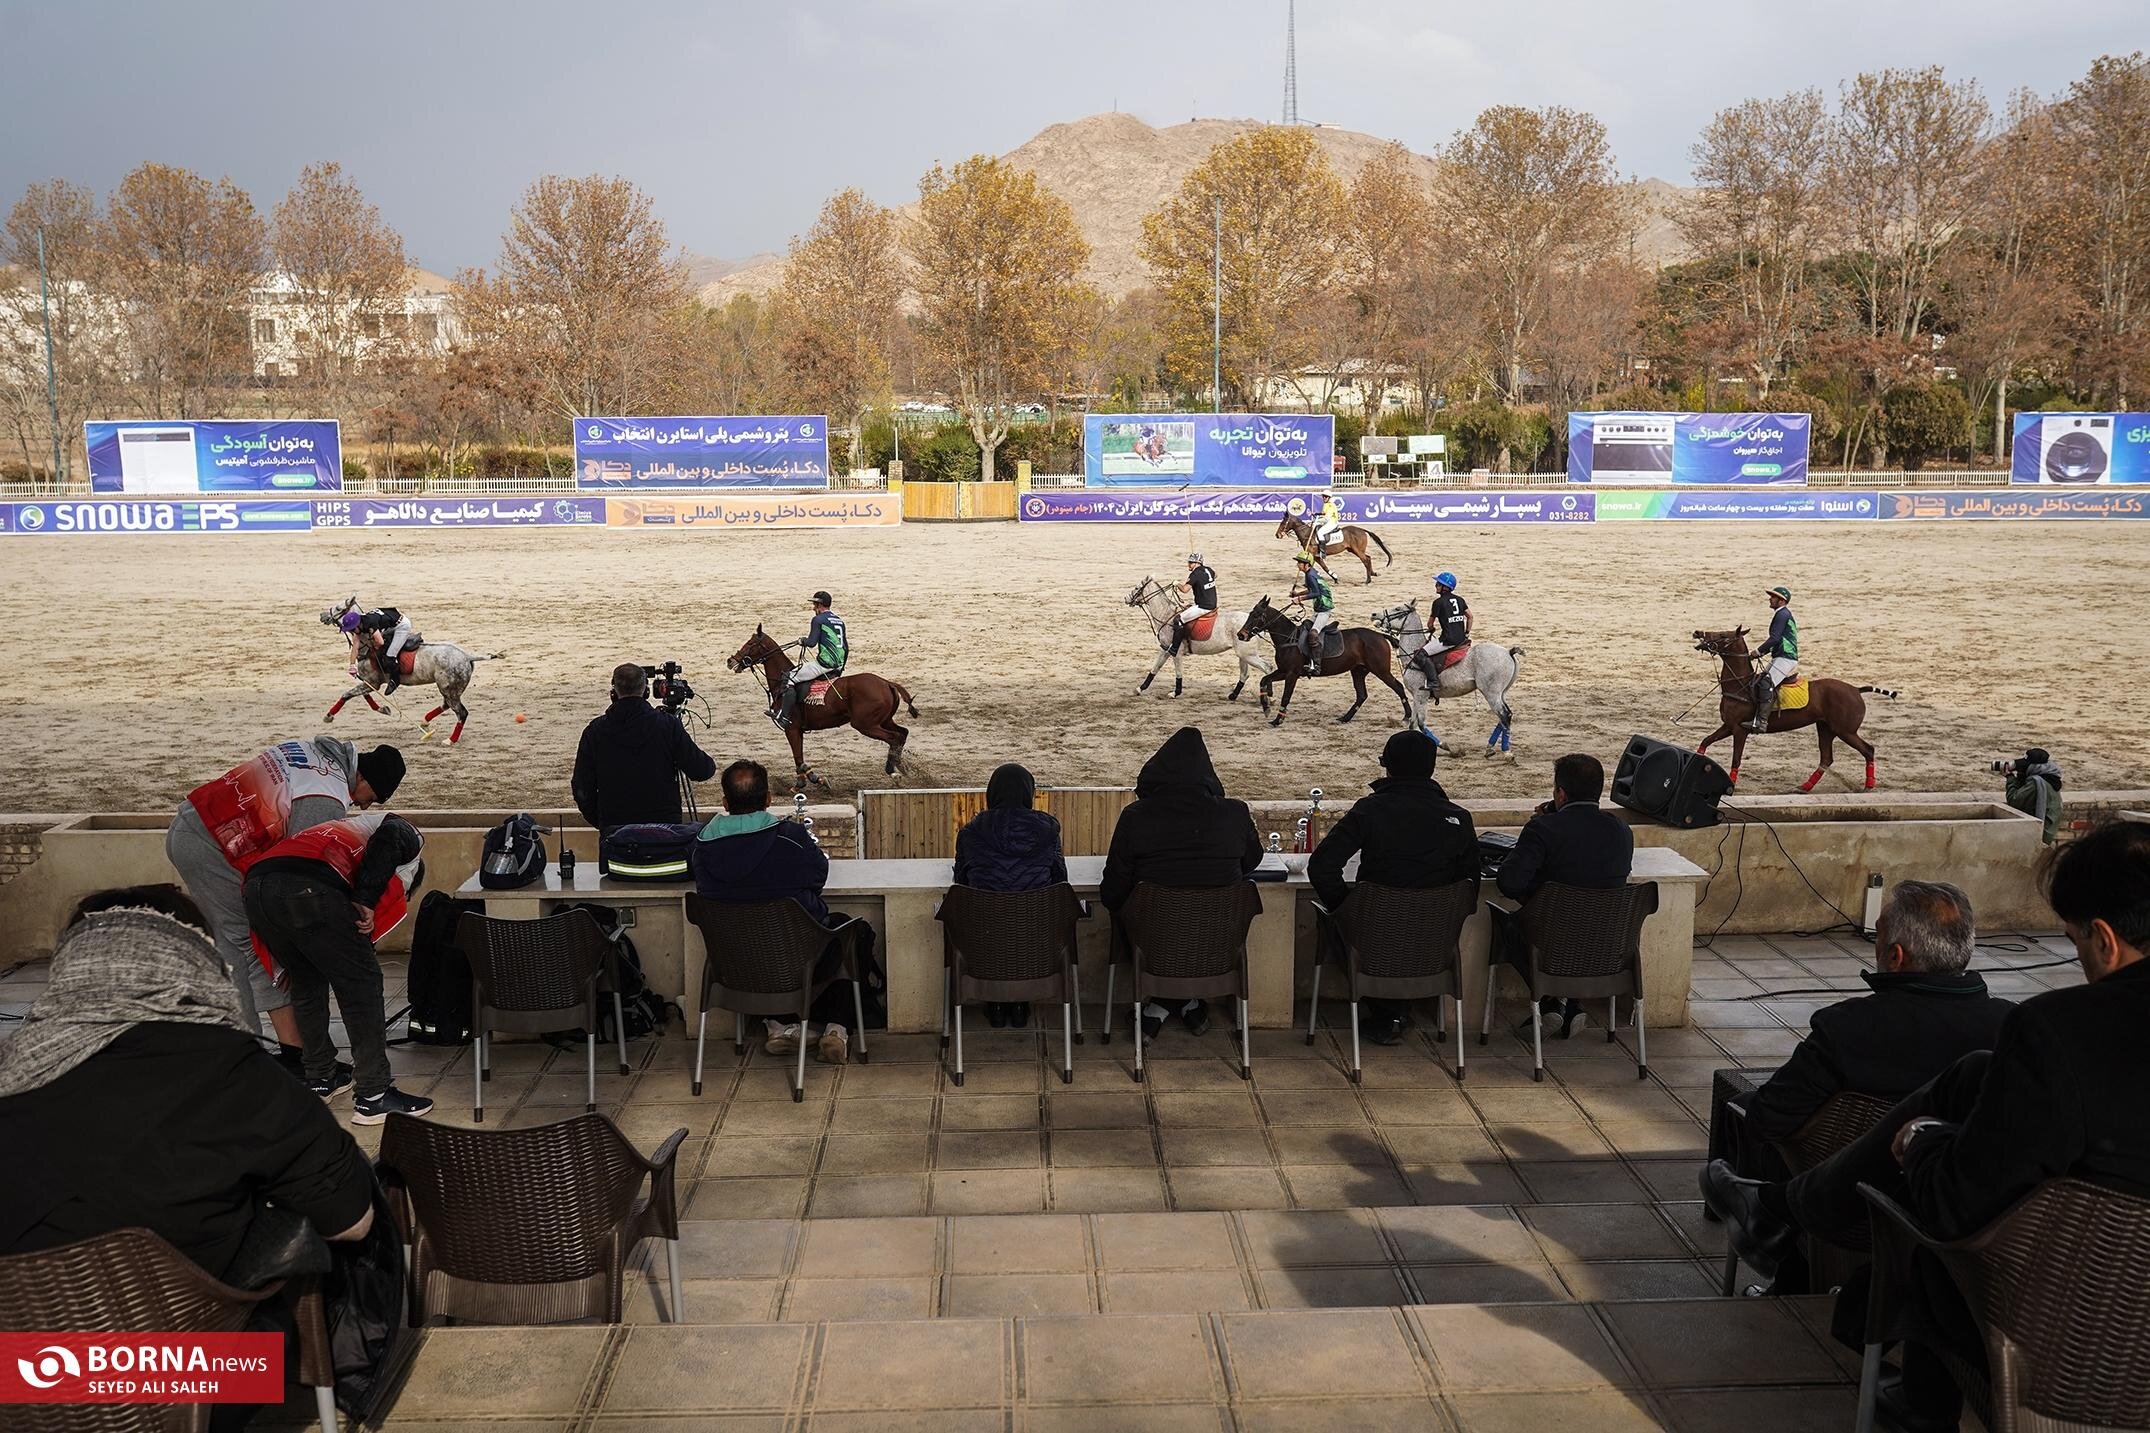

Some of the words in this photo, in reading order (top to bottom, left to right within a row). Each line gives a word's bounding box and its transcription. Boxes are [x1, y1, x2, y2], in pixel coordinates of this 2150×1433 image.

[612, 426, 655, 444] انتخاب
[656, 426, 704, 445] استایرن
[705, 426, 728, 444] پلی
[1209, 426, 1254, 445] تجربه
[1689, 426, 1746, 442] خوشمزگی
[211, 434, 267, 452] آسودگی
[1268, 447, 1307, 459] تلویزیون
[636, 463, 675, 480] المللی
[675, 465, 701, 479] بین
[701, 467, 710, 479] و
[712, 462, 751, 479] داخلی
[316, 502, 351, 513] HIPS
[364, 502, 427, 525] دالاهو
[430, 502, 490, 525] صنایع
[492, 501, 545, 523] کیمیا
[763, 505, 806, 523] داخلی
[1115, 500, 1143, 516] ایران
[1144, 500, 1180, 516] چوگان
[1179, 501, 1200, 516] ملی
[1202, 500, 1223, 515] لیگ
[1224, 502, 1263, 516] هجدهم
[1264, 501, 1287, 514] هفته
[1365, 496, 1433, 519] سپیدان
[1434, 496, 1490, 518] شیمی
[1489, 496, 1542, 519] بسپار
[1601, 502, 1642, 510] snowa.ir
[1821, 500, 1854, 513] اسنوا
[1951, 498, 1991, 517] المللی
[1991, 502, 2017, 516] بین
[2019, 502, 2028, 516] و
[2028, 498, 2071, 516] داخلی
[55, 504, 174, 530] snowa
[181, 503, 240, 530] EPS
[316, 515, 351, 526] GPPS
[681, 505, 722, 524] المللی
[725, 510, 751, 524] بین
[753, 510, 761, 524] و
[1549, 511, 1589, 521] 031-8282
[1204, 568, 1213, 582] 1
[1449, 598, 1460, 615] 3
[833, 624, 843, 648] 3
